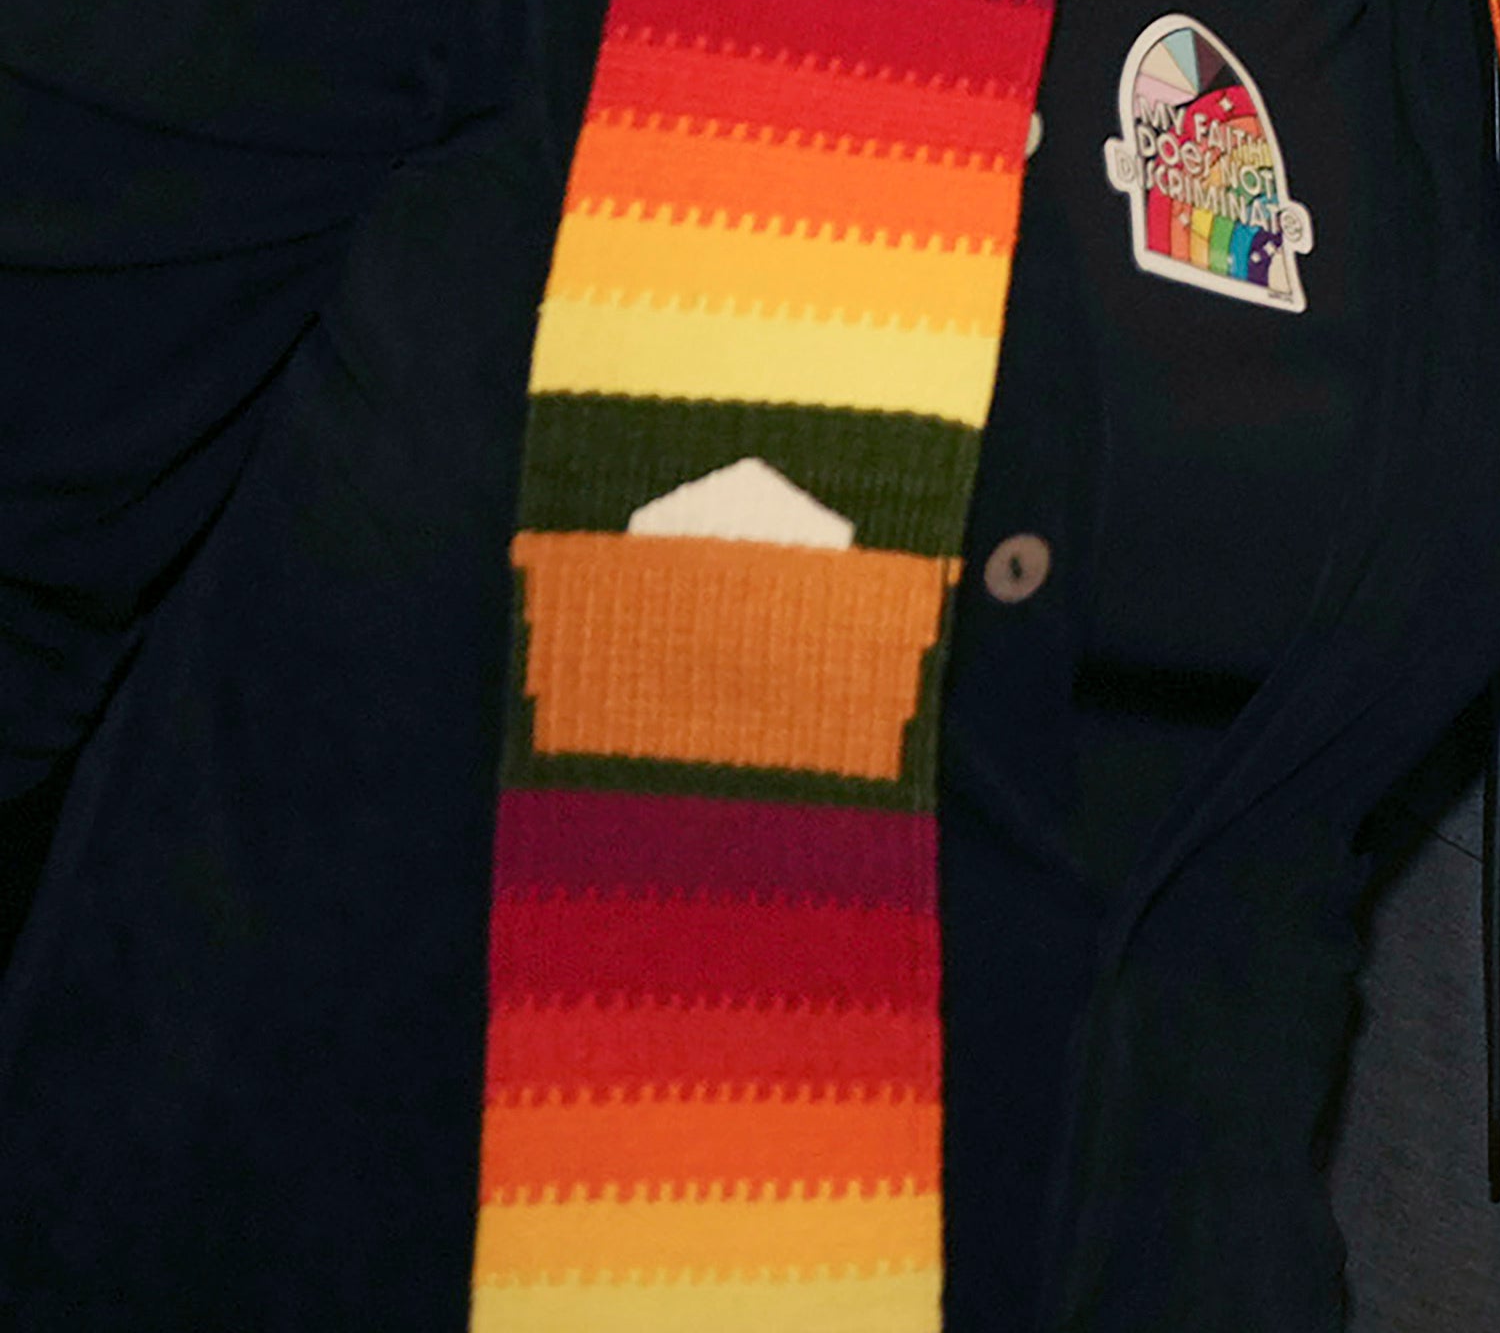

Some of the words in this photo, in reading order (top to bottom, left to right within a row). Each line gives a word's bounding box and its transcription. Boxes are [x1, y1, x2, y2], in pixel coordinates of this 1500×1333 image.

[1137, 96, 1186, 136] MY
[1193, 113, 1274, 169] FAITH
[1220, 156, 1275, 200] NOT
